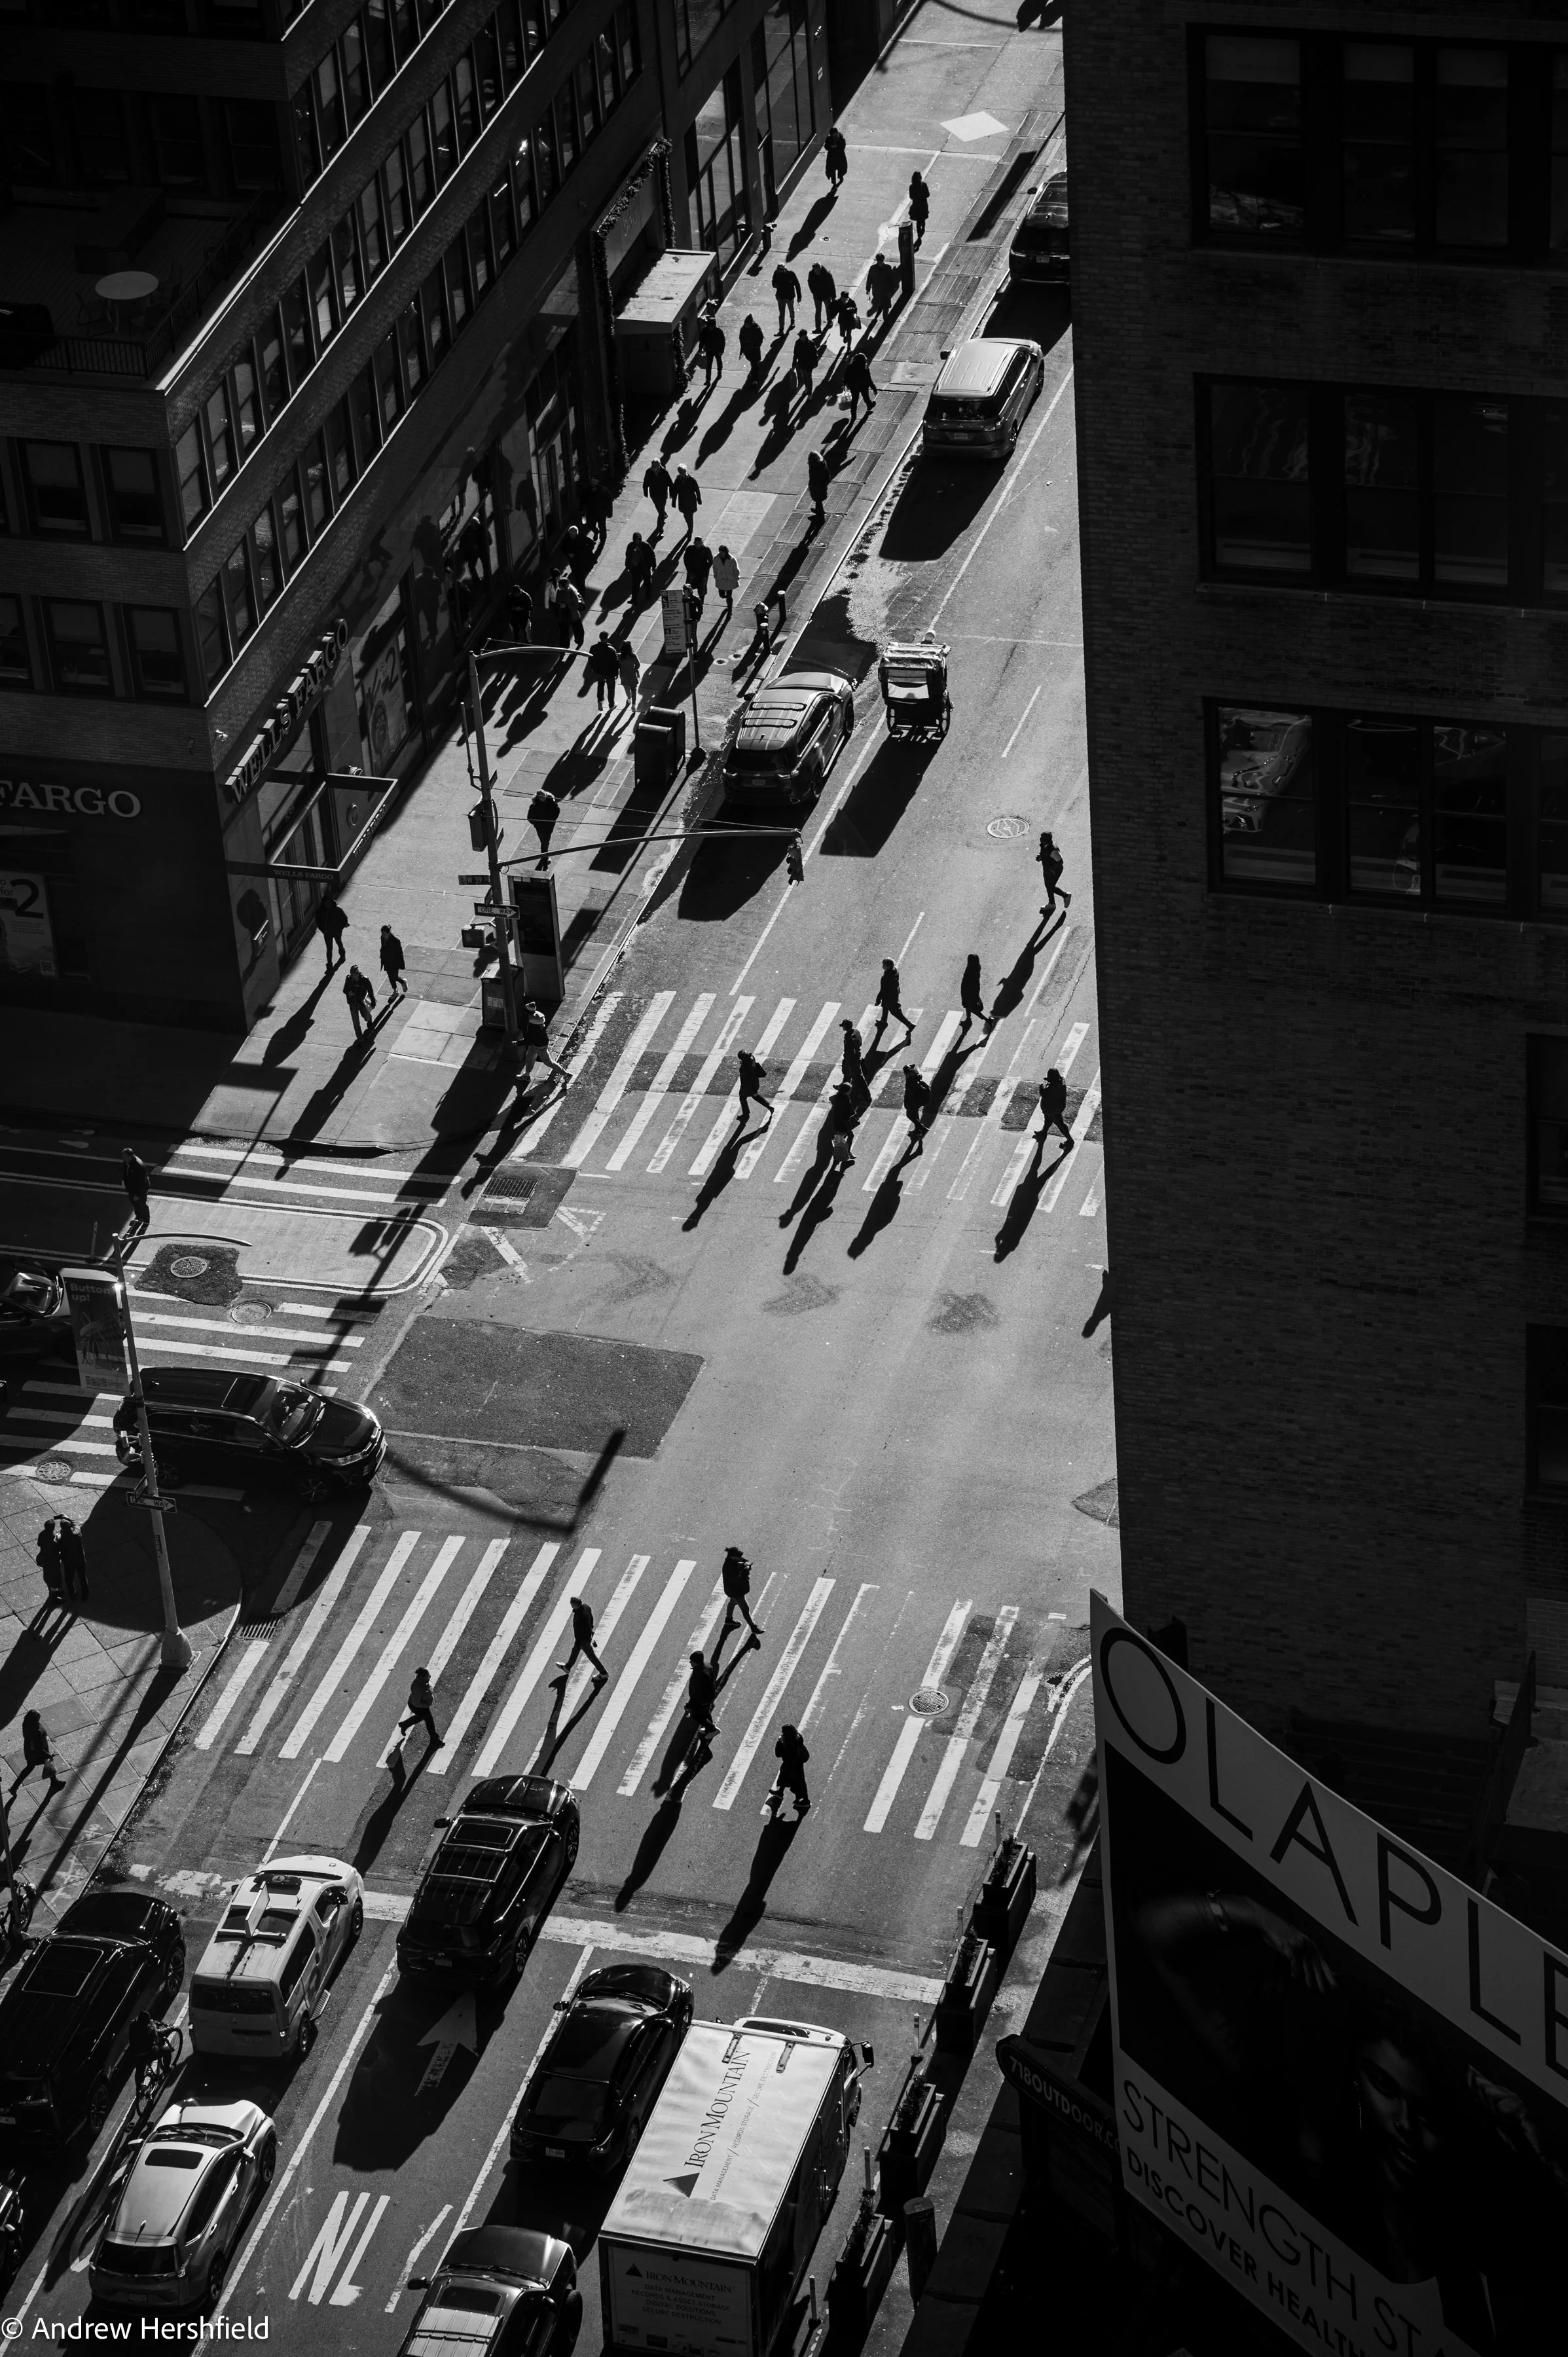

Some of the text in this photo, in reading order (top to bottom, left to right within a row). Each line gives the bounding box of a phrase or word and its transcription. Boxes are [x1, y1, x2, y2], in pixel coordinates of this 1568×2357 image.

[225, 619, 348, 804] WELLS FARGO
[0, 780, 141, 818] FARGO
[274, 869, 334, 881] WELLS FARGO
[10, 879, 44, 919] 2
[70, 1283, 110, 1294] Button
[71, 1294, 90, 1303] up!
[684, 2051, 751, 2168] IRON MOUNTAIN
[716, 2155, 734, 2188] MANAGEMENT
[733, 2126, 746, 2148] RECORDS
[741, 2106, 754, 2127] STORAGE
[753, 2081, 765, 2100] SECURE
[761, 2051, 778, 2083] DESTRUCTION
[1123, 2080, 1447, 2357] STRENGTH ST
[1127, 2146, 1370, 2357] DISCOVER HEALTH
[646, 2271, 731, 2293] IRON MOUNTAIN
[632, 2290, 665, 2300] RECORDS
[674, 2296, 695, 2305] ASSET
[698, 2301, 731, 2312] STORAGE
[665, 2288, 716, 2301] MANAGEMENT
[642, 2306, 721, 2326] SECURE DESTRUCTION
[646, 2299, 716, 2316] DIGITAL SOLUTIONS
